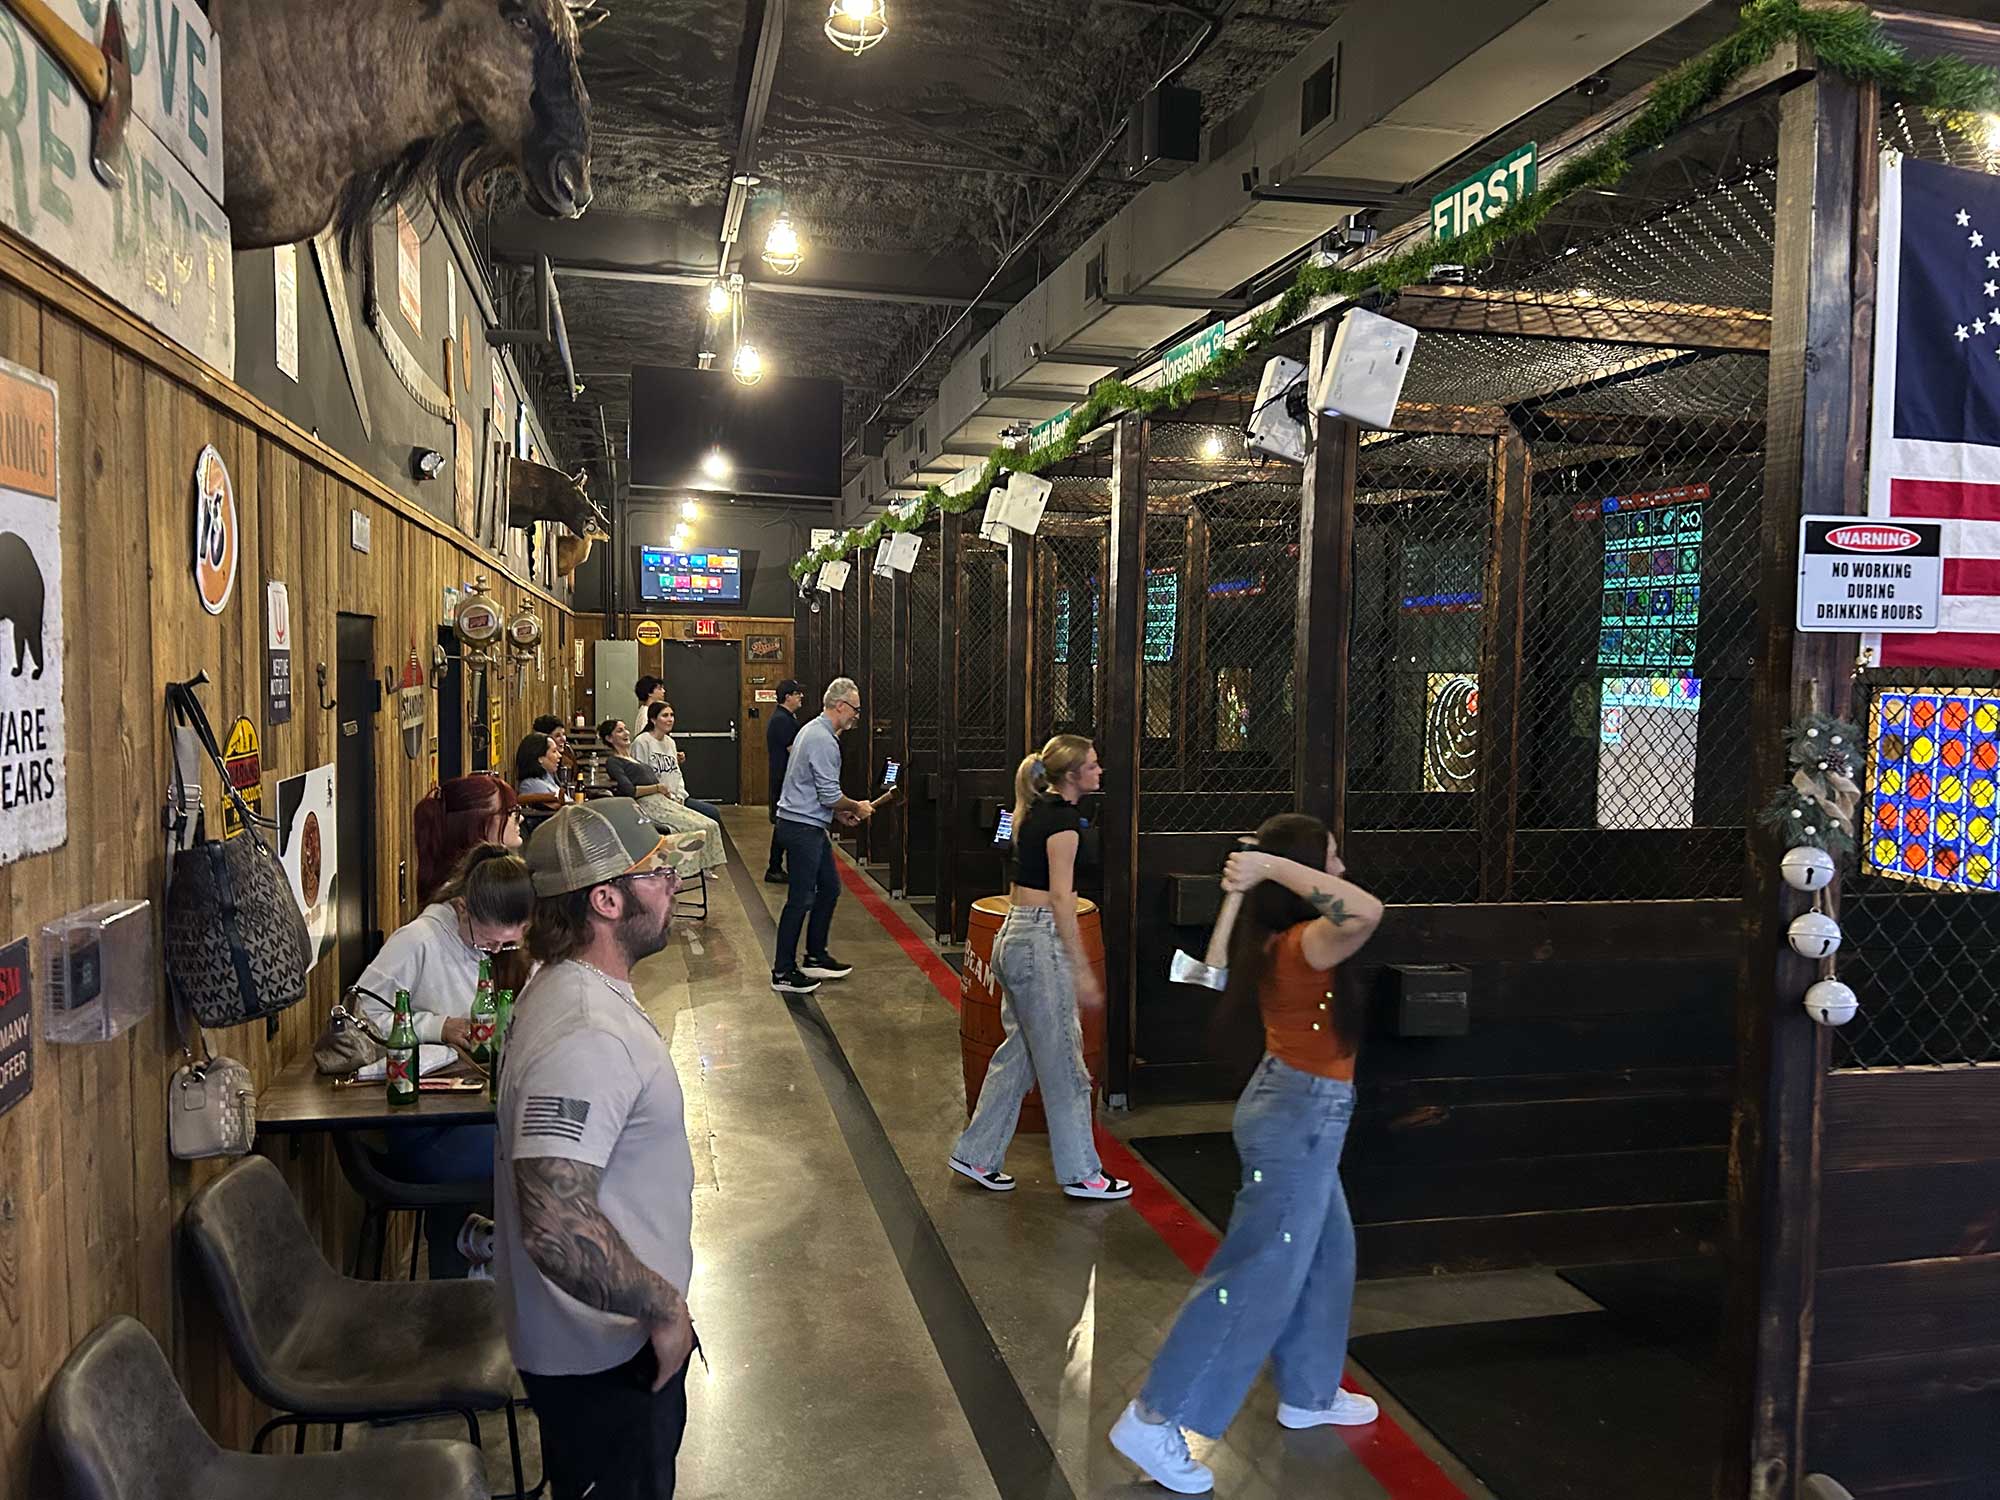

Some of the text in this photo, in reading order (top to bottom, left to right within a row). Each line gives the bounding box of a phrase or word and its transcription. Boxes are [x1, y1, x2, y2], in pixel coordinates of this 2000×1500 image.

[1434, 152, 1532, 243] FIRST
[1162, 341, 1211, 387] Horseshoe
[0, 408, 47, 479] NING
[1835, 531, 1911, 546] WARNING
[1832, 562, 1912, 578] NO WORKING
[1847, 583, 1895, 599] DURING
[1817, 603, 1923, 620] DRINKING HOURS
[696, 620, 716, 635] EXIT
[1, 758, 55, 810] EARS
[964, 938, 996, 998] BEAM
